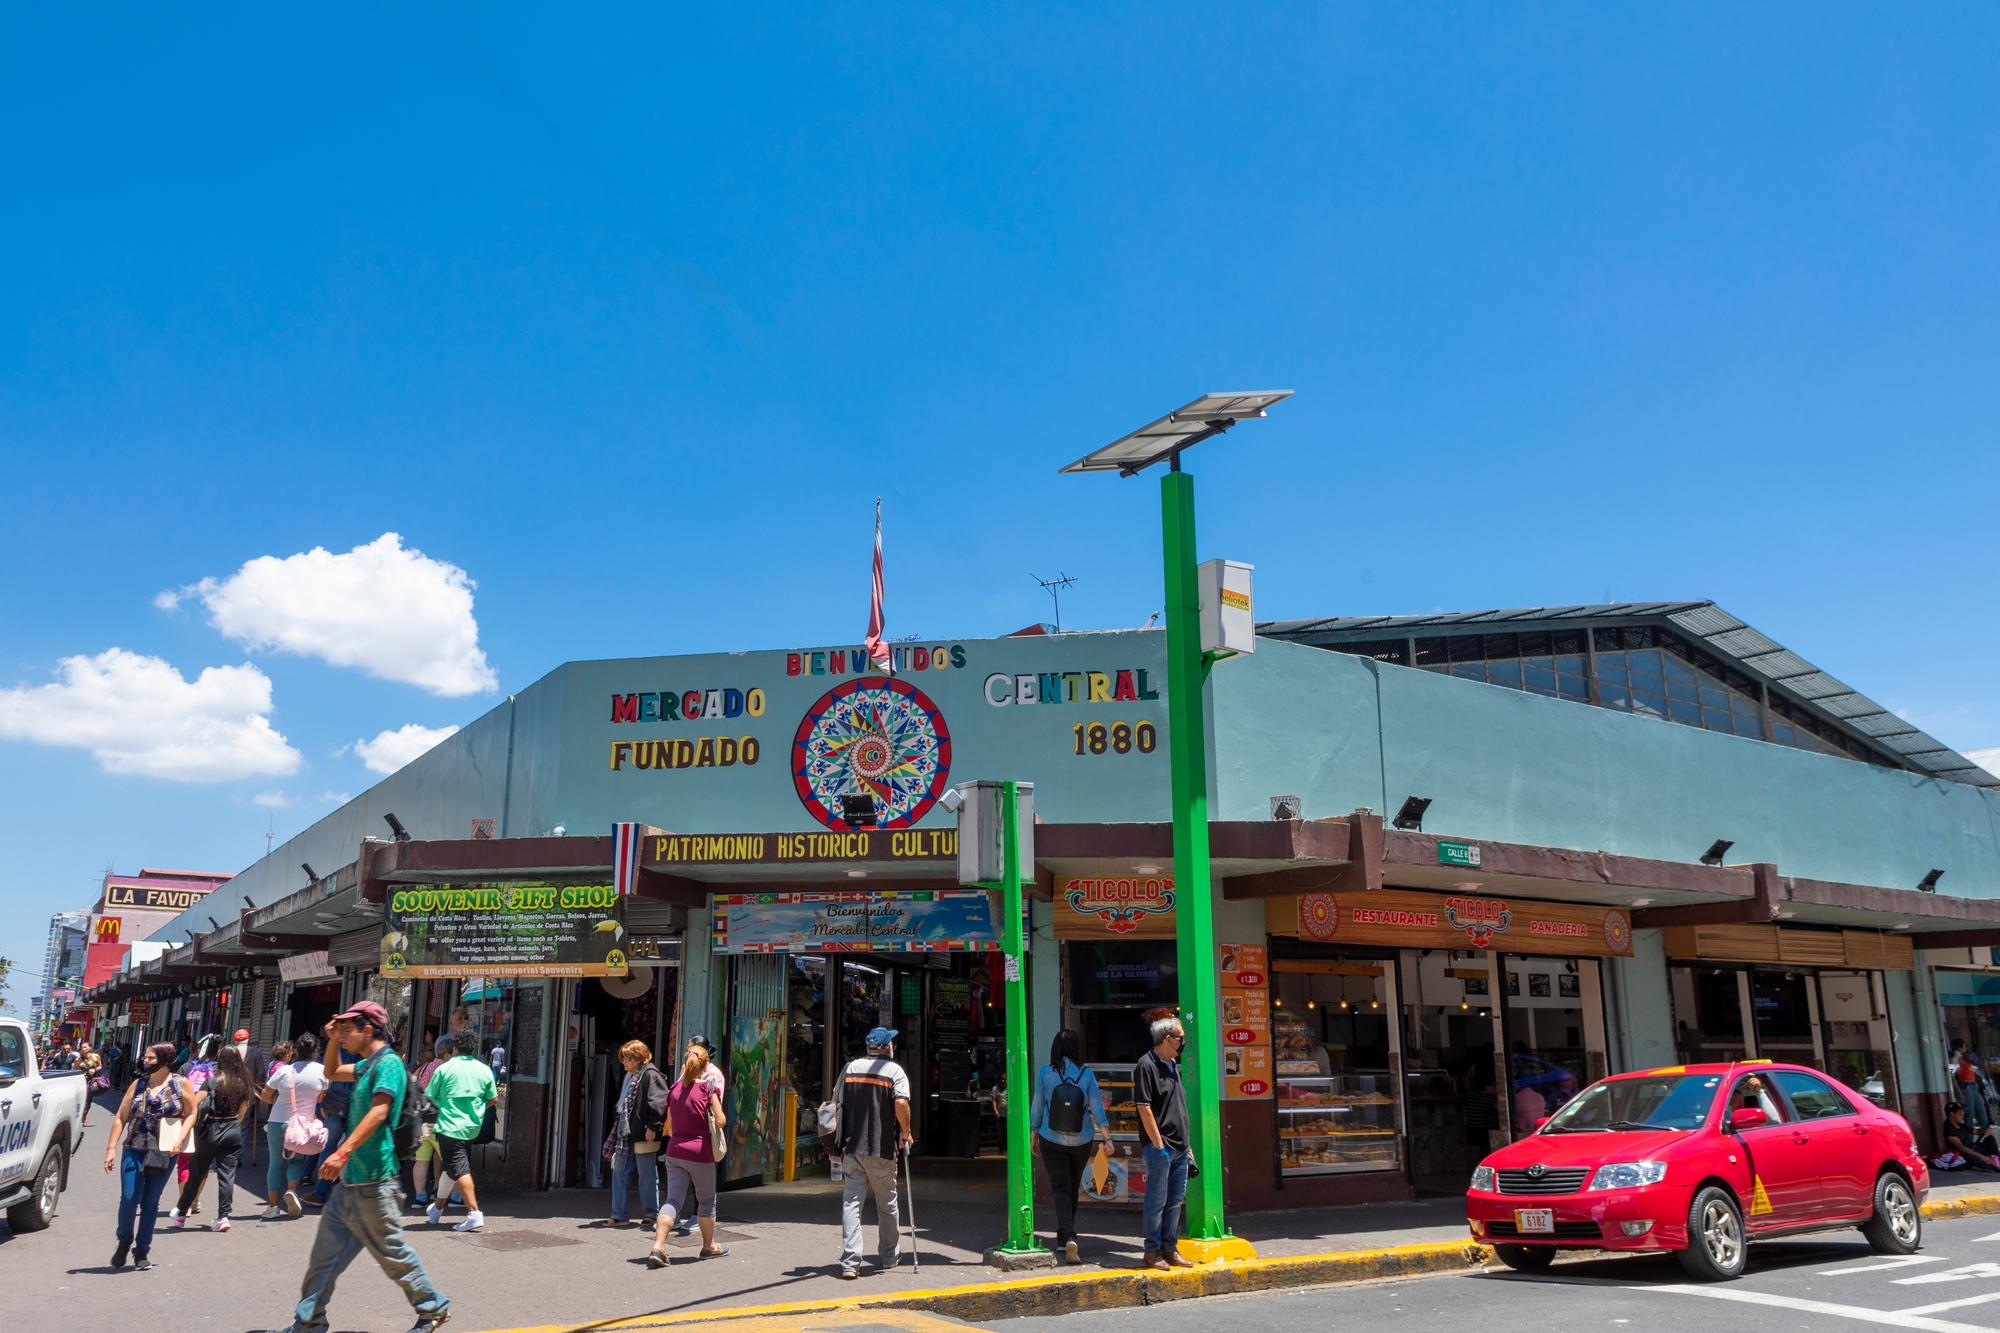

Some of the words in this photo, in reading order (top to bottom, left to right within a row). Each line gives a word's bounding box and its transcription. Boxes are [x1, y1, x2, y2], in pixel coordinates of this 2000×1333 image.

[610, 687, 766, 723] MERCADO
[983, 668, 1160, 707] CENTRAL
[609, 735, 760, 771] FUNDADO
[1072, 719, 1157, 756] 1880
[655, 835, 765, 861] PATRIMONIO
[777, 832, 869, 859] HISTORICO
[1447, 848, 1464, 858] CALLE
[111, 888, 134, 904] LA
[146, 890, 207, 907] FAVOR
[392, 888, 502, 912] SOUVENIR
[506, 886, 557, 910] GIFT
[1081, 879, 1160, 901] TICOLO
[825, 902, 904, 917] Bienvenidos
[1352, 908, 1437, 927] RESTAURANTE
[1454, 897, 1500, 919] TICOLO
[813, 922, 867, 936] Mercado
[871, 921, 920, 937] Central
